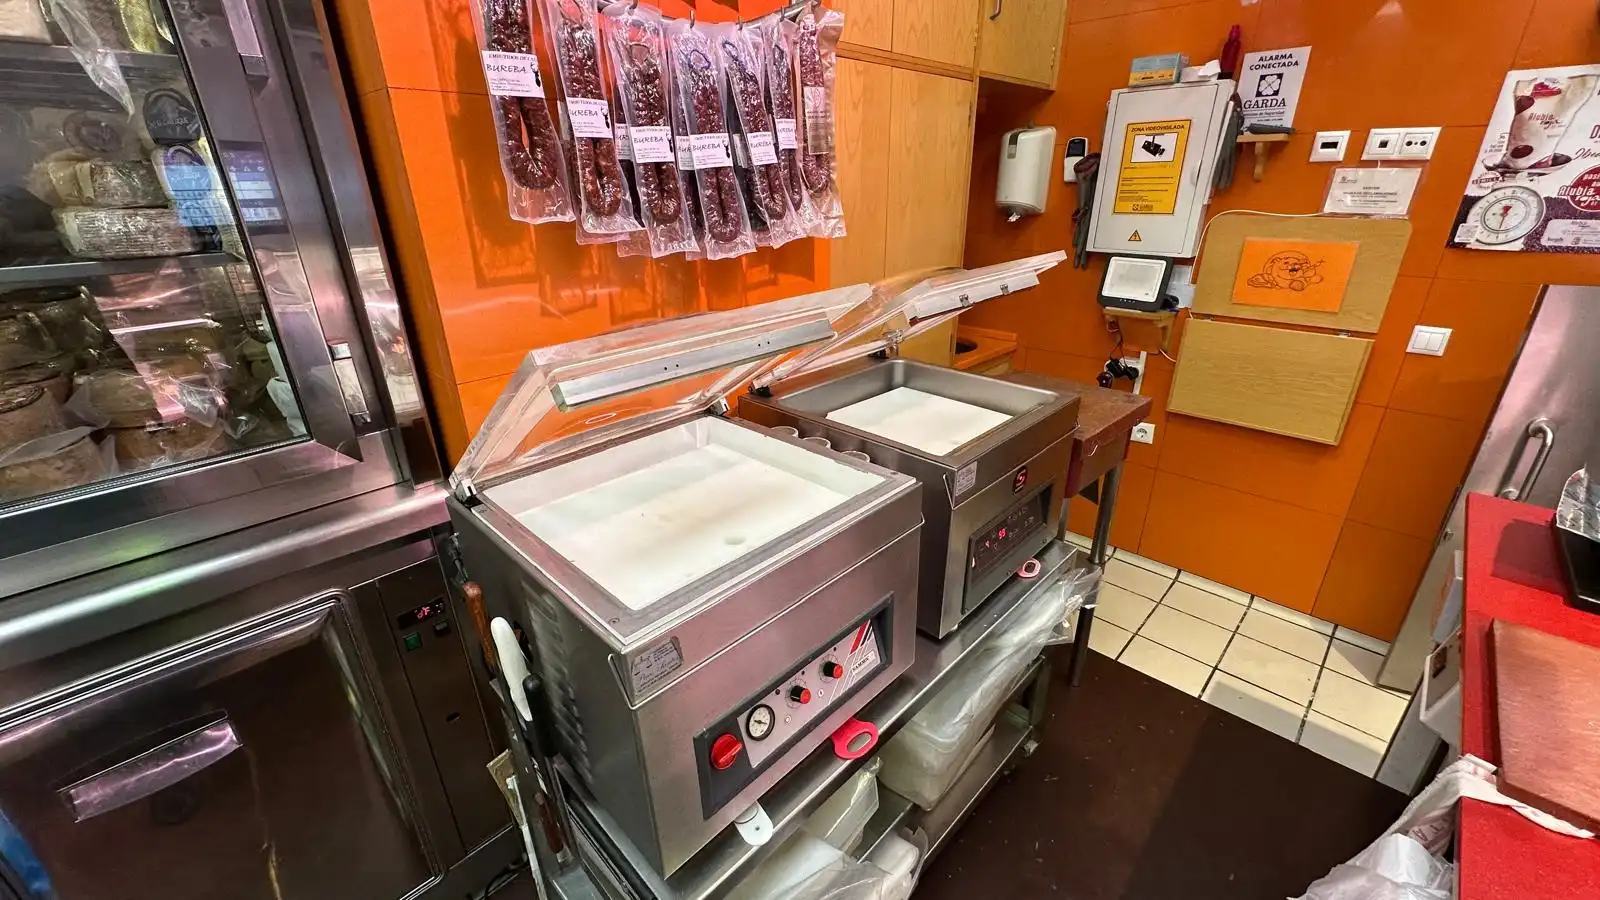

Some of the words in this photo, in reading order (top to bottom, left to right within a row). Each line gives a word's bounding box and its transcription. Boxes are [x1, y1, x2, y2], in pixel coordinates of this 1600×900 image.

[1258, 53, 1293, 62] ALARMA
[486, 64, 527, 73] BUREBA
[1249, 60, 1299, 71] CONECTADA
[1243, 98, 1287, 110] GARDA
[1145, 124, 1185, 132] VIDEOVIGILADA
[634, 136, 664, 144] BUREBA
[692, 143, 721, 152] BUREBA
[1559, 184, 1595, 197] Alubia
